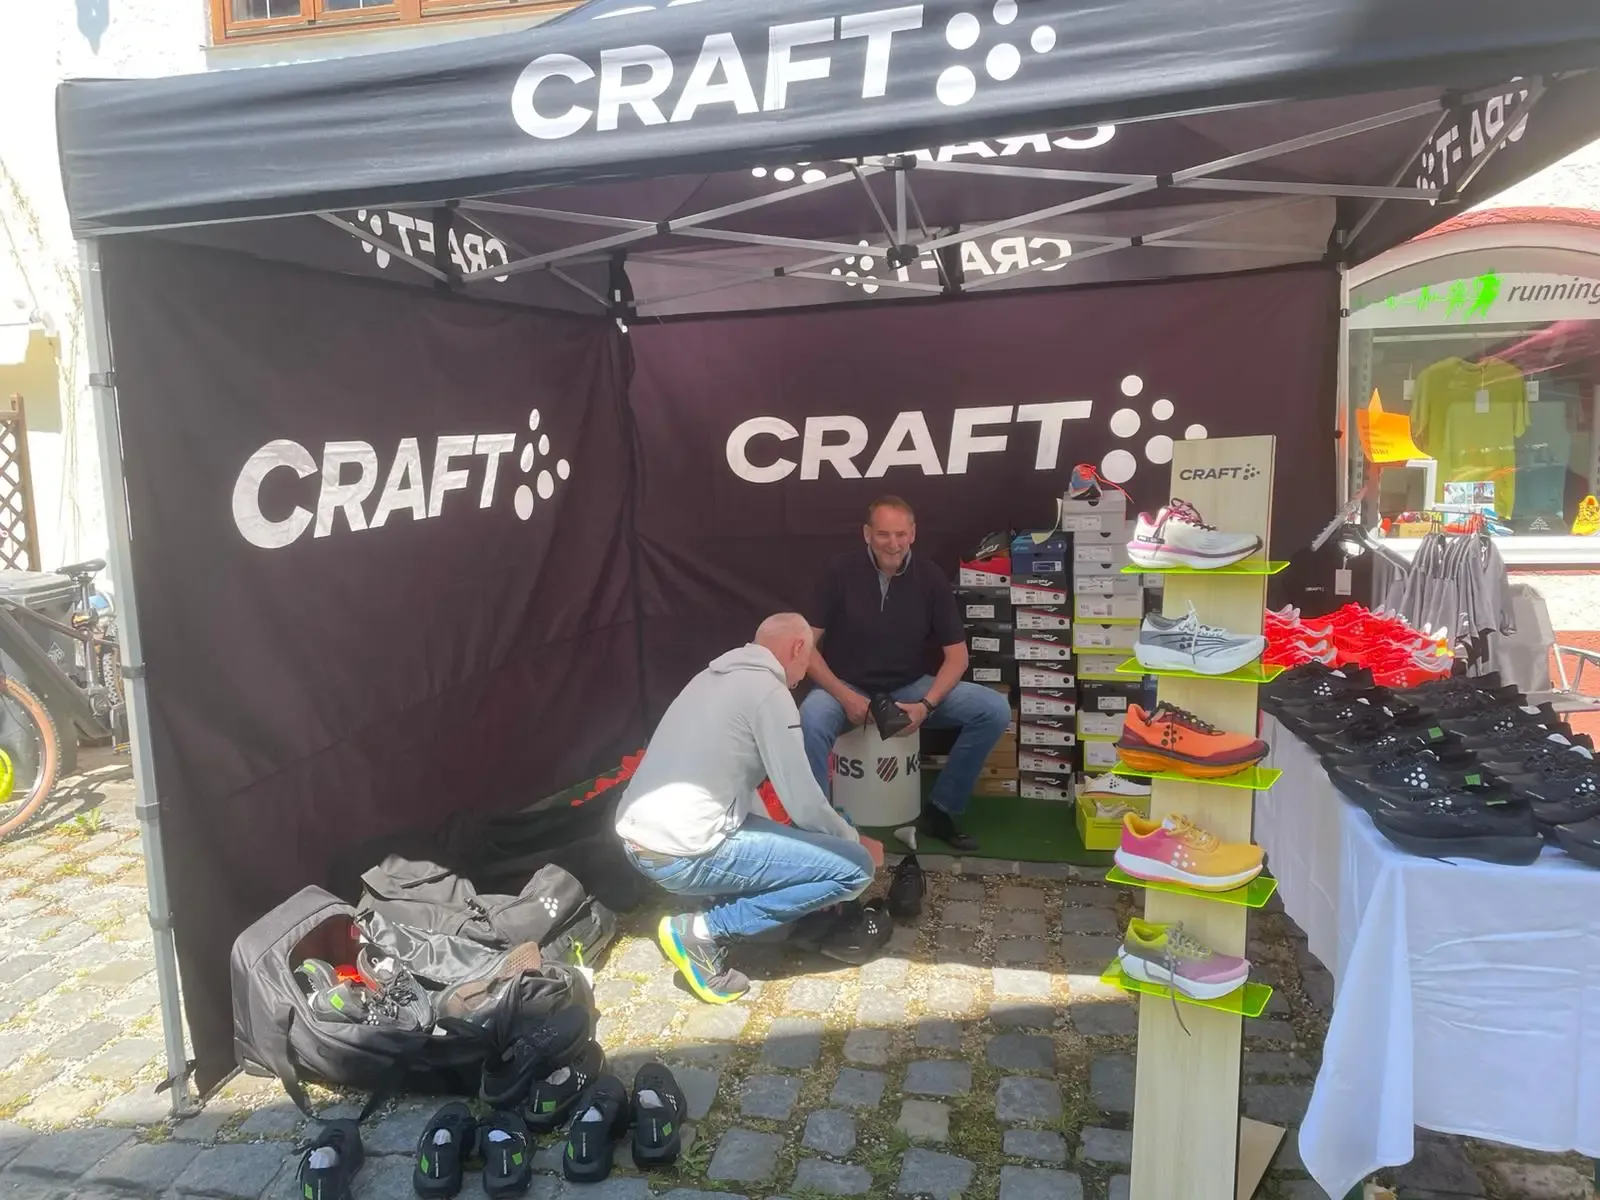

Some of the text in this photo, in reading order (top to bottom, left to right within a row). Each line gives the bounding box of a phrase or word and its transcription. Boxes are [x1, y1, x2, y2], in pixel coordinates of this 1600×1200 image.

[511, 4, 924, 139] CRAFT
[1507, 277, 1600, 304] running
[726, 400, 1093, 484] CRAFT
[1180, 467, 1242, 480] CRAFT
[232, 433, 516, 549] CRAFT
